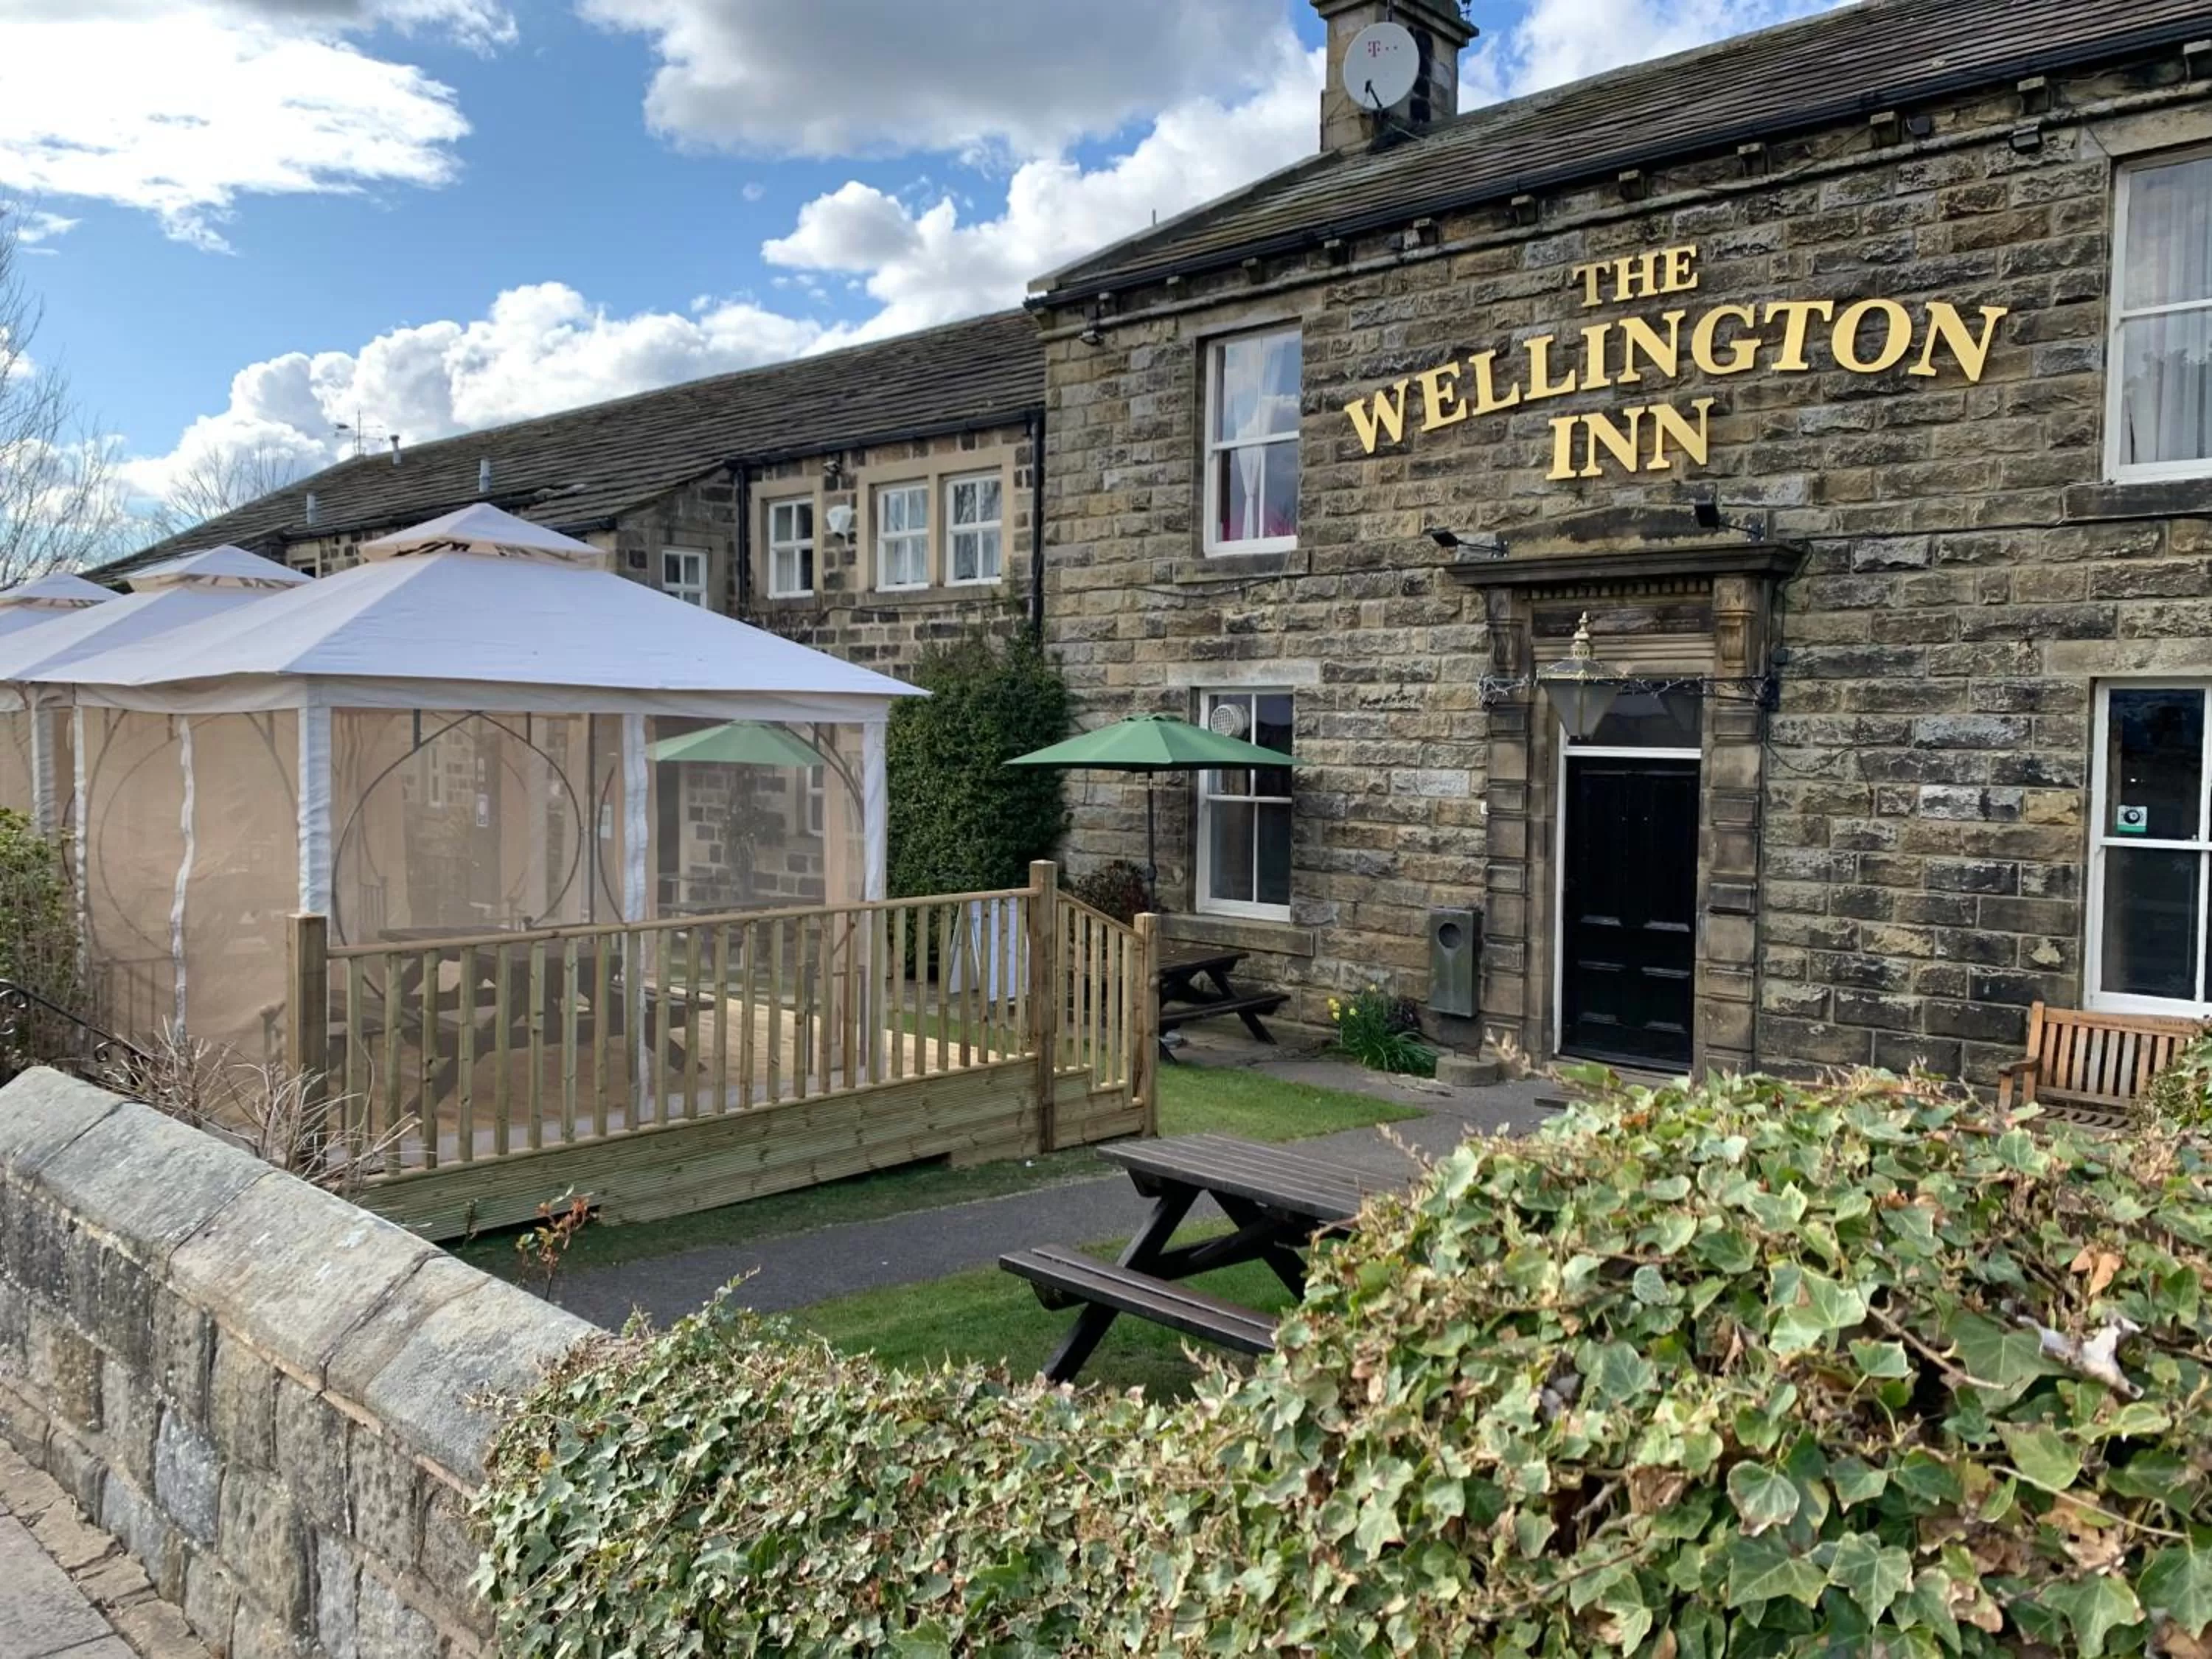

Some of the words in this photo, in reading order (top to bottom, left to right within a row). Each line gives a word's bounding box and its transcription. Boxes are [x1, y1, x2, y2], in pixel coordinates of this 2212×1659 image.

[1572, 245, 1699, 307] THE
[1343, 298, 2008, 455] WELLINGTON
[1545, 397, 1714, 480] INN
